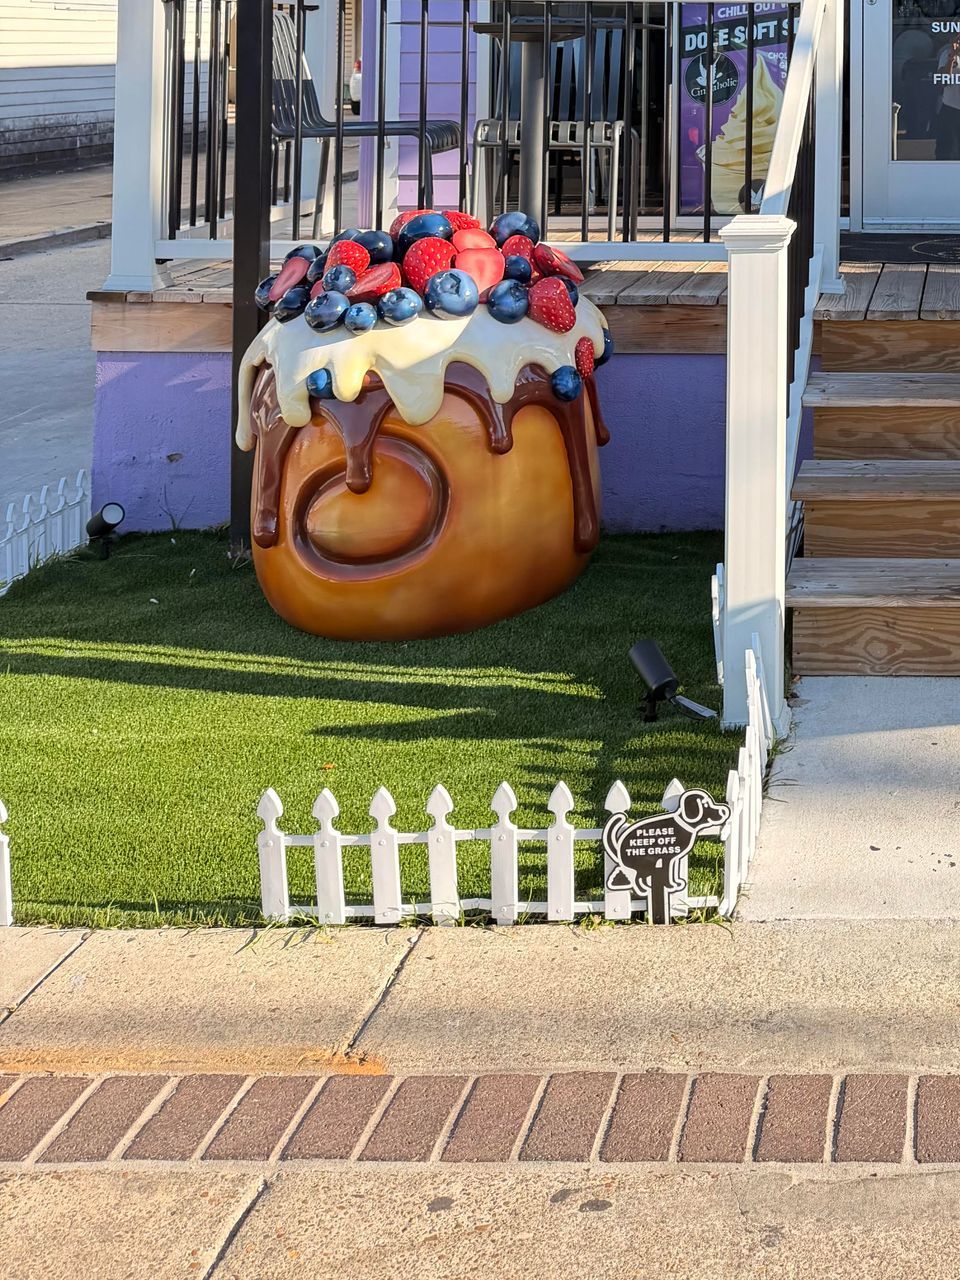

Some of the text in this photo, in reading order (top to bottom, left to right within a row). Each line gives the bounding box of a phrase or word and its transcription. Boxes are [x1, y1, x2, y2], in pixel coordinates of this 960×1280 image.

[684, 28, 729, 52] DOE
[636, 827, 674, 837] PLEASE
[629, 836, 677, 847] KEEP OFF
[625, 845, 681, 857] THE GRASS
